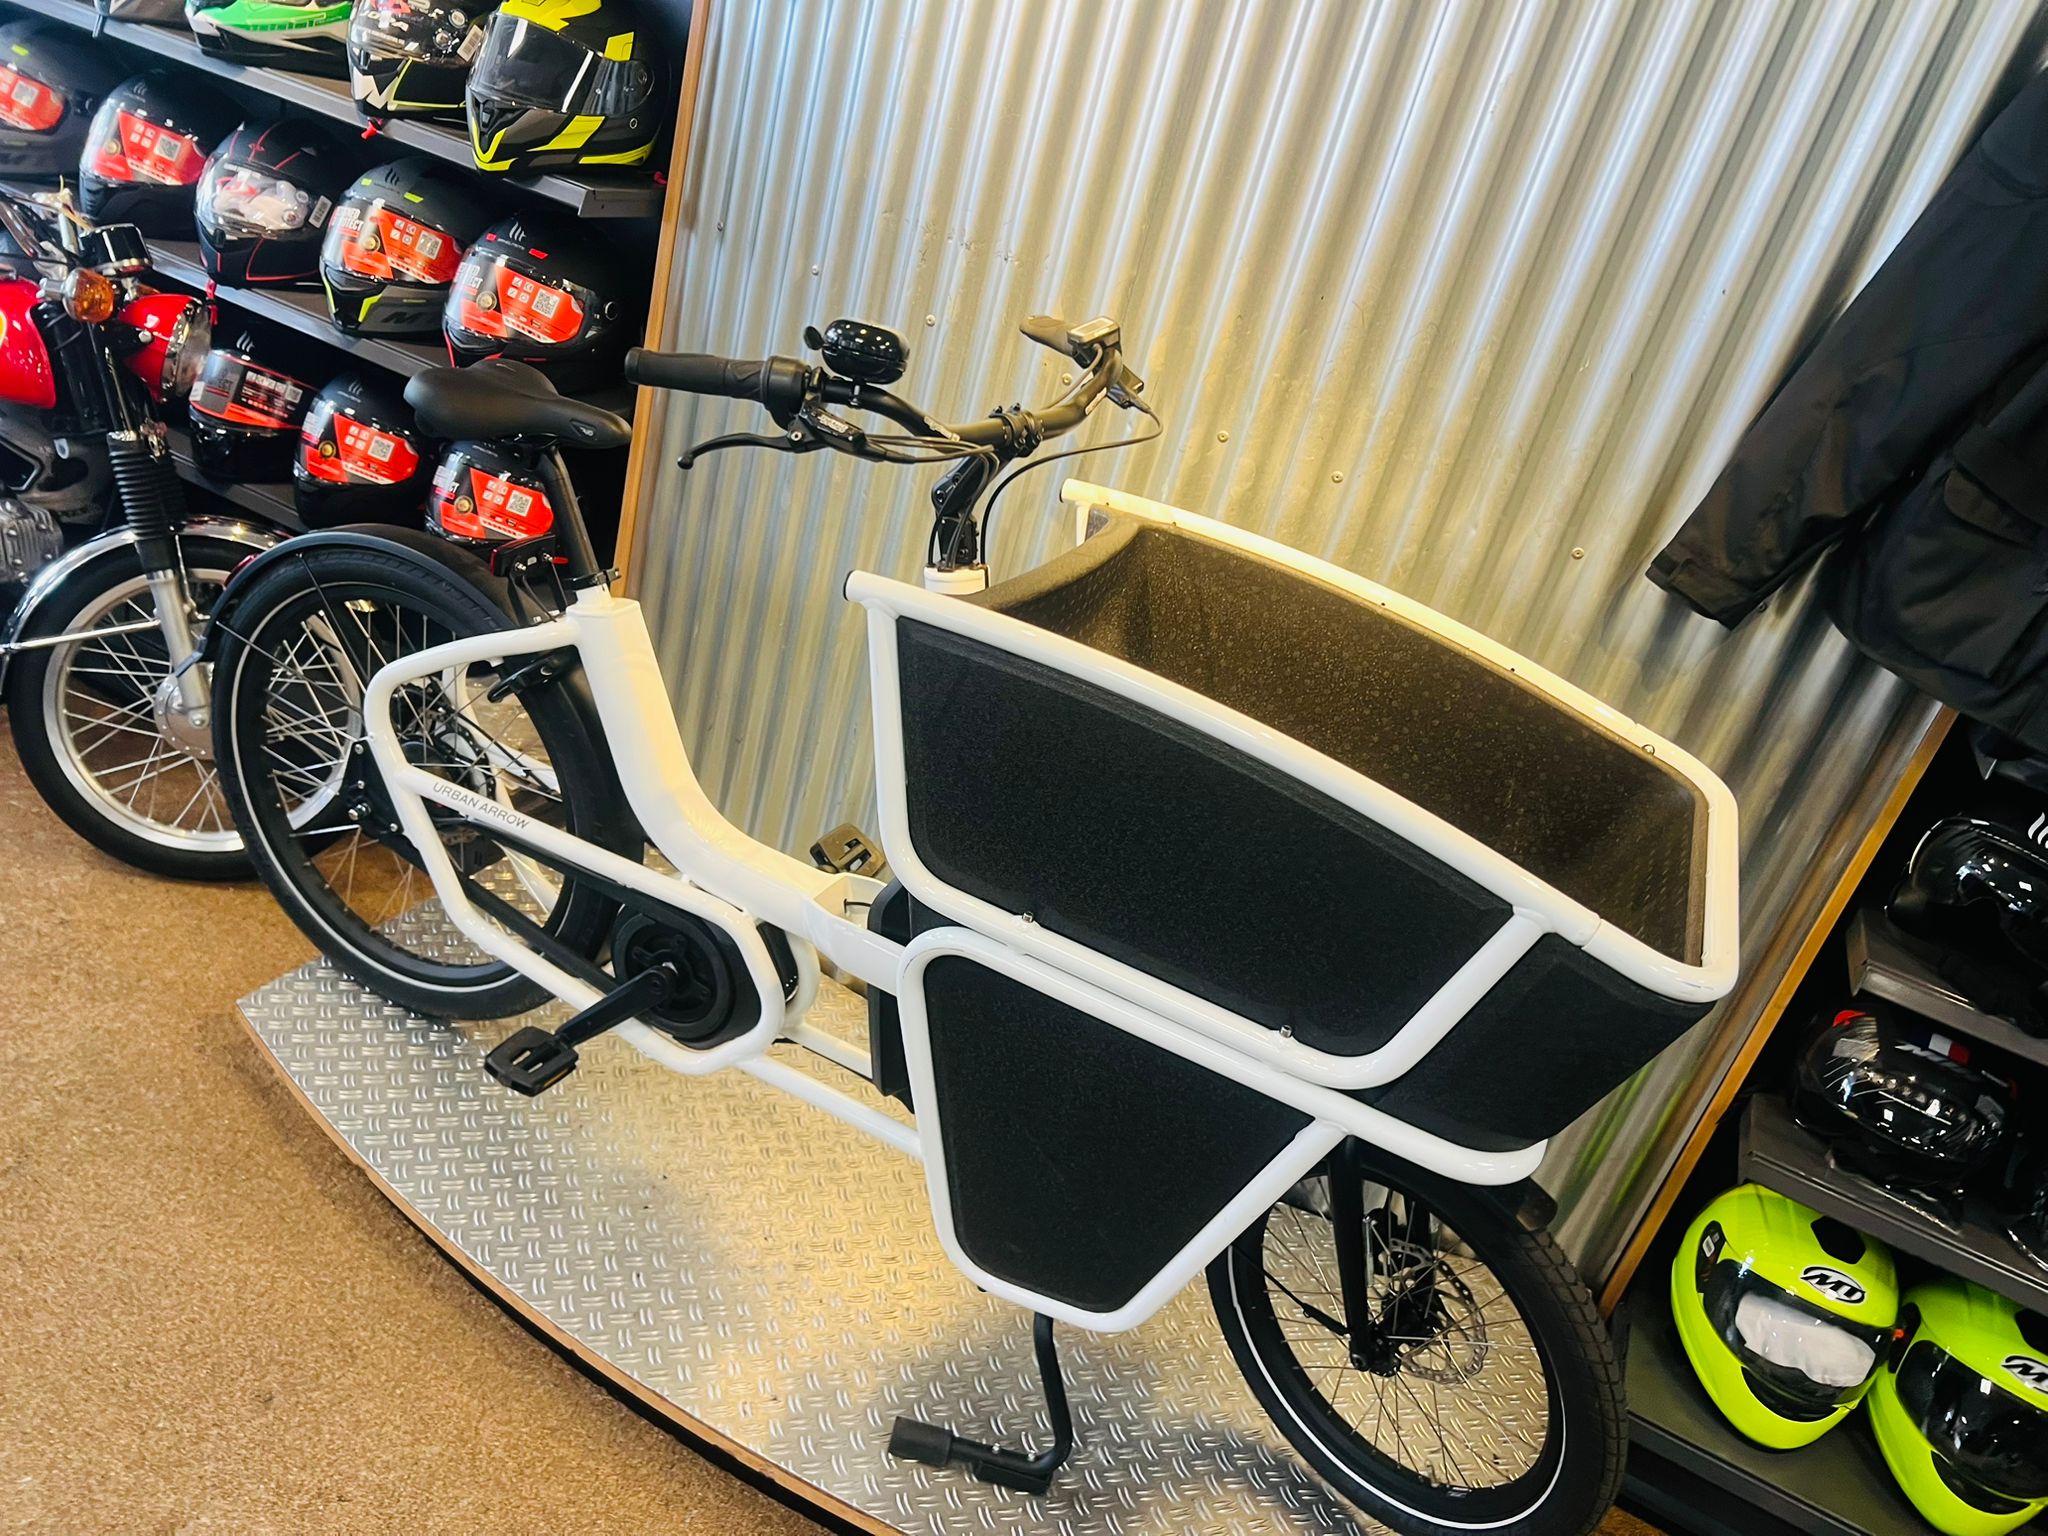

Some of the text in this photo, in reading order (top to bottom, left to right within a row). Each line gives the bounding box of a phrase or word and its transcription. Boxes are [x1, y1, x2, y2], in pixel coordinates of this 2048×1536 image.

[432, 781, 531, 830] URBAN ARROW
[1800, 1270, 1866, 1300] MT
[2001, 1362, 2048, 1386] M
